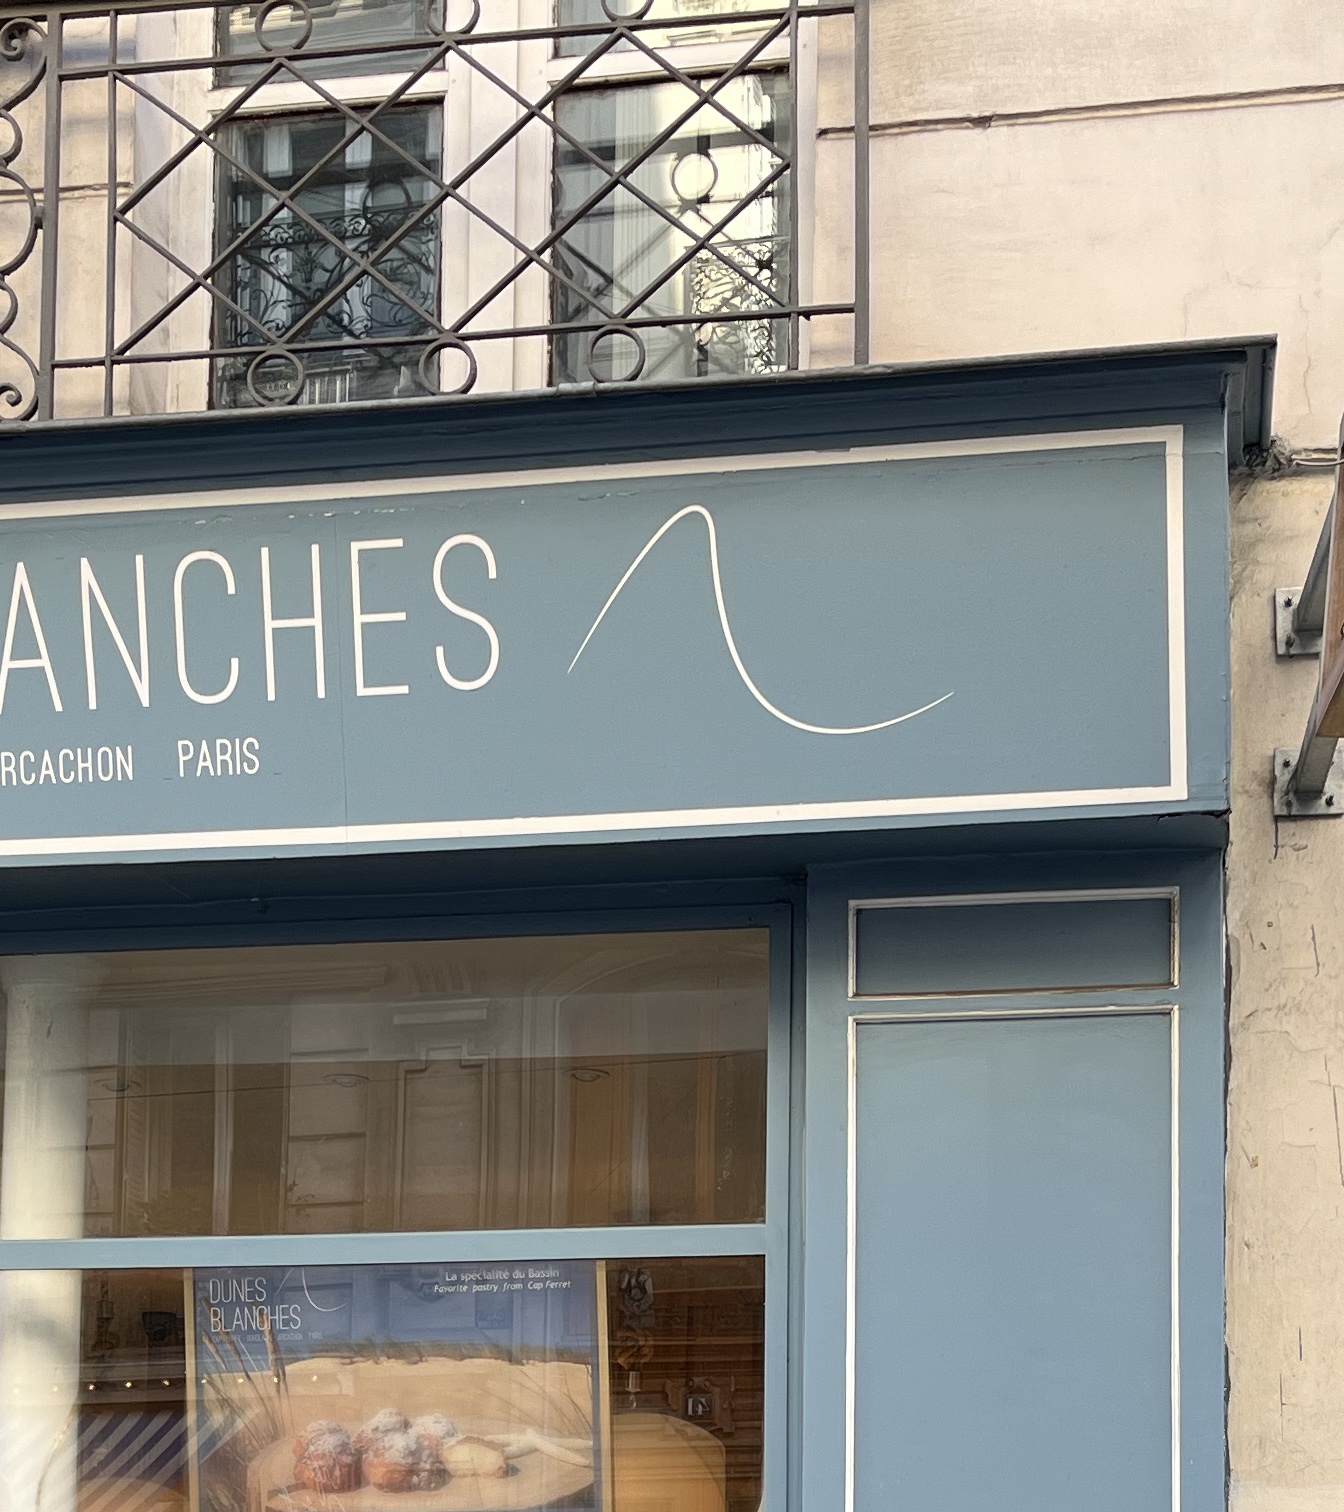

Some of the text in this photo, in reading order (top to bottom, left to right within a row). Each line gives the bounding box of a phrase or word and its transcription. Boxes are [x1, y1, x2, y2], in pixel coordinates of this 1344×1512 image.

[177, 737, 260, 778] PARIS
[434, 1280, 572, 1293] Favorite pastry from Cap Ferret
[446, 1271, 457, 1281] La
[513, 1269, 525, 1279] du
[528, 1267, 560, 1279] Bassin
[209, 1276, 267, 1304] DUNES
[210, 1304, 302, 1333] BLANCHES
